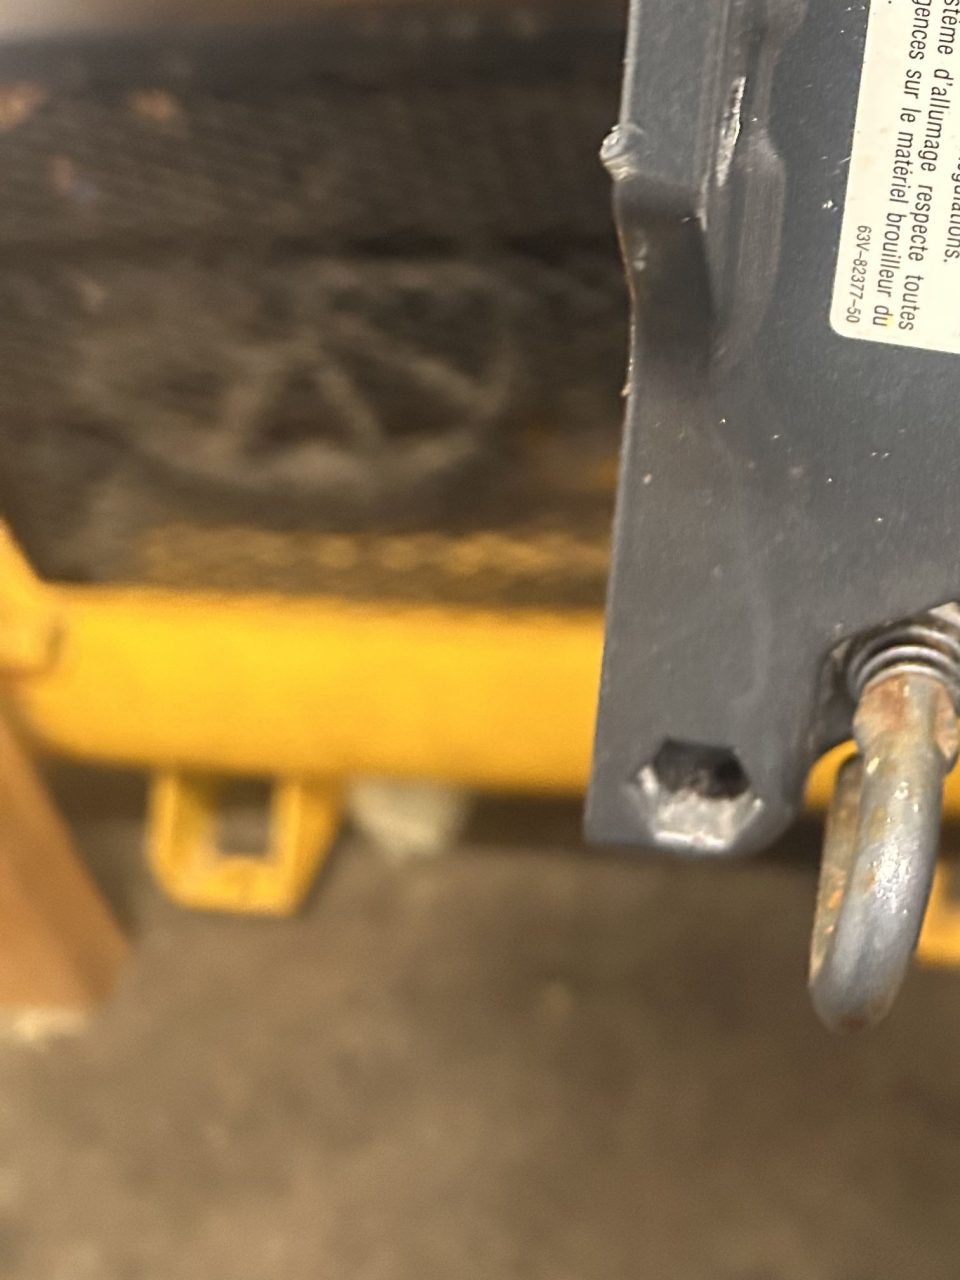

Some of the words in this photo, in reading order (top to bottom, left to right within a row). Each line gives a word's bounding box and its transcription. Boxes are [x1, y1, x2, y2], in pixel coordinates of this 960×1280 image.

[899, 107, 922, 123] le
[903, 69, 922, 100] sur
[917, 68, 954, 172] d'allumage
[889, 131, 914, 204] matériel
[876, 212, 907, 298] brouilleur
[907, 184, 933, 262] respecte
[845, 225, 873, 324] 63V-82377-50
[898, 274, 924, 331] toutes
[872, 304, 894, 327] du
